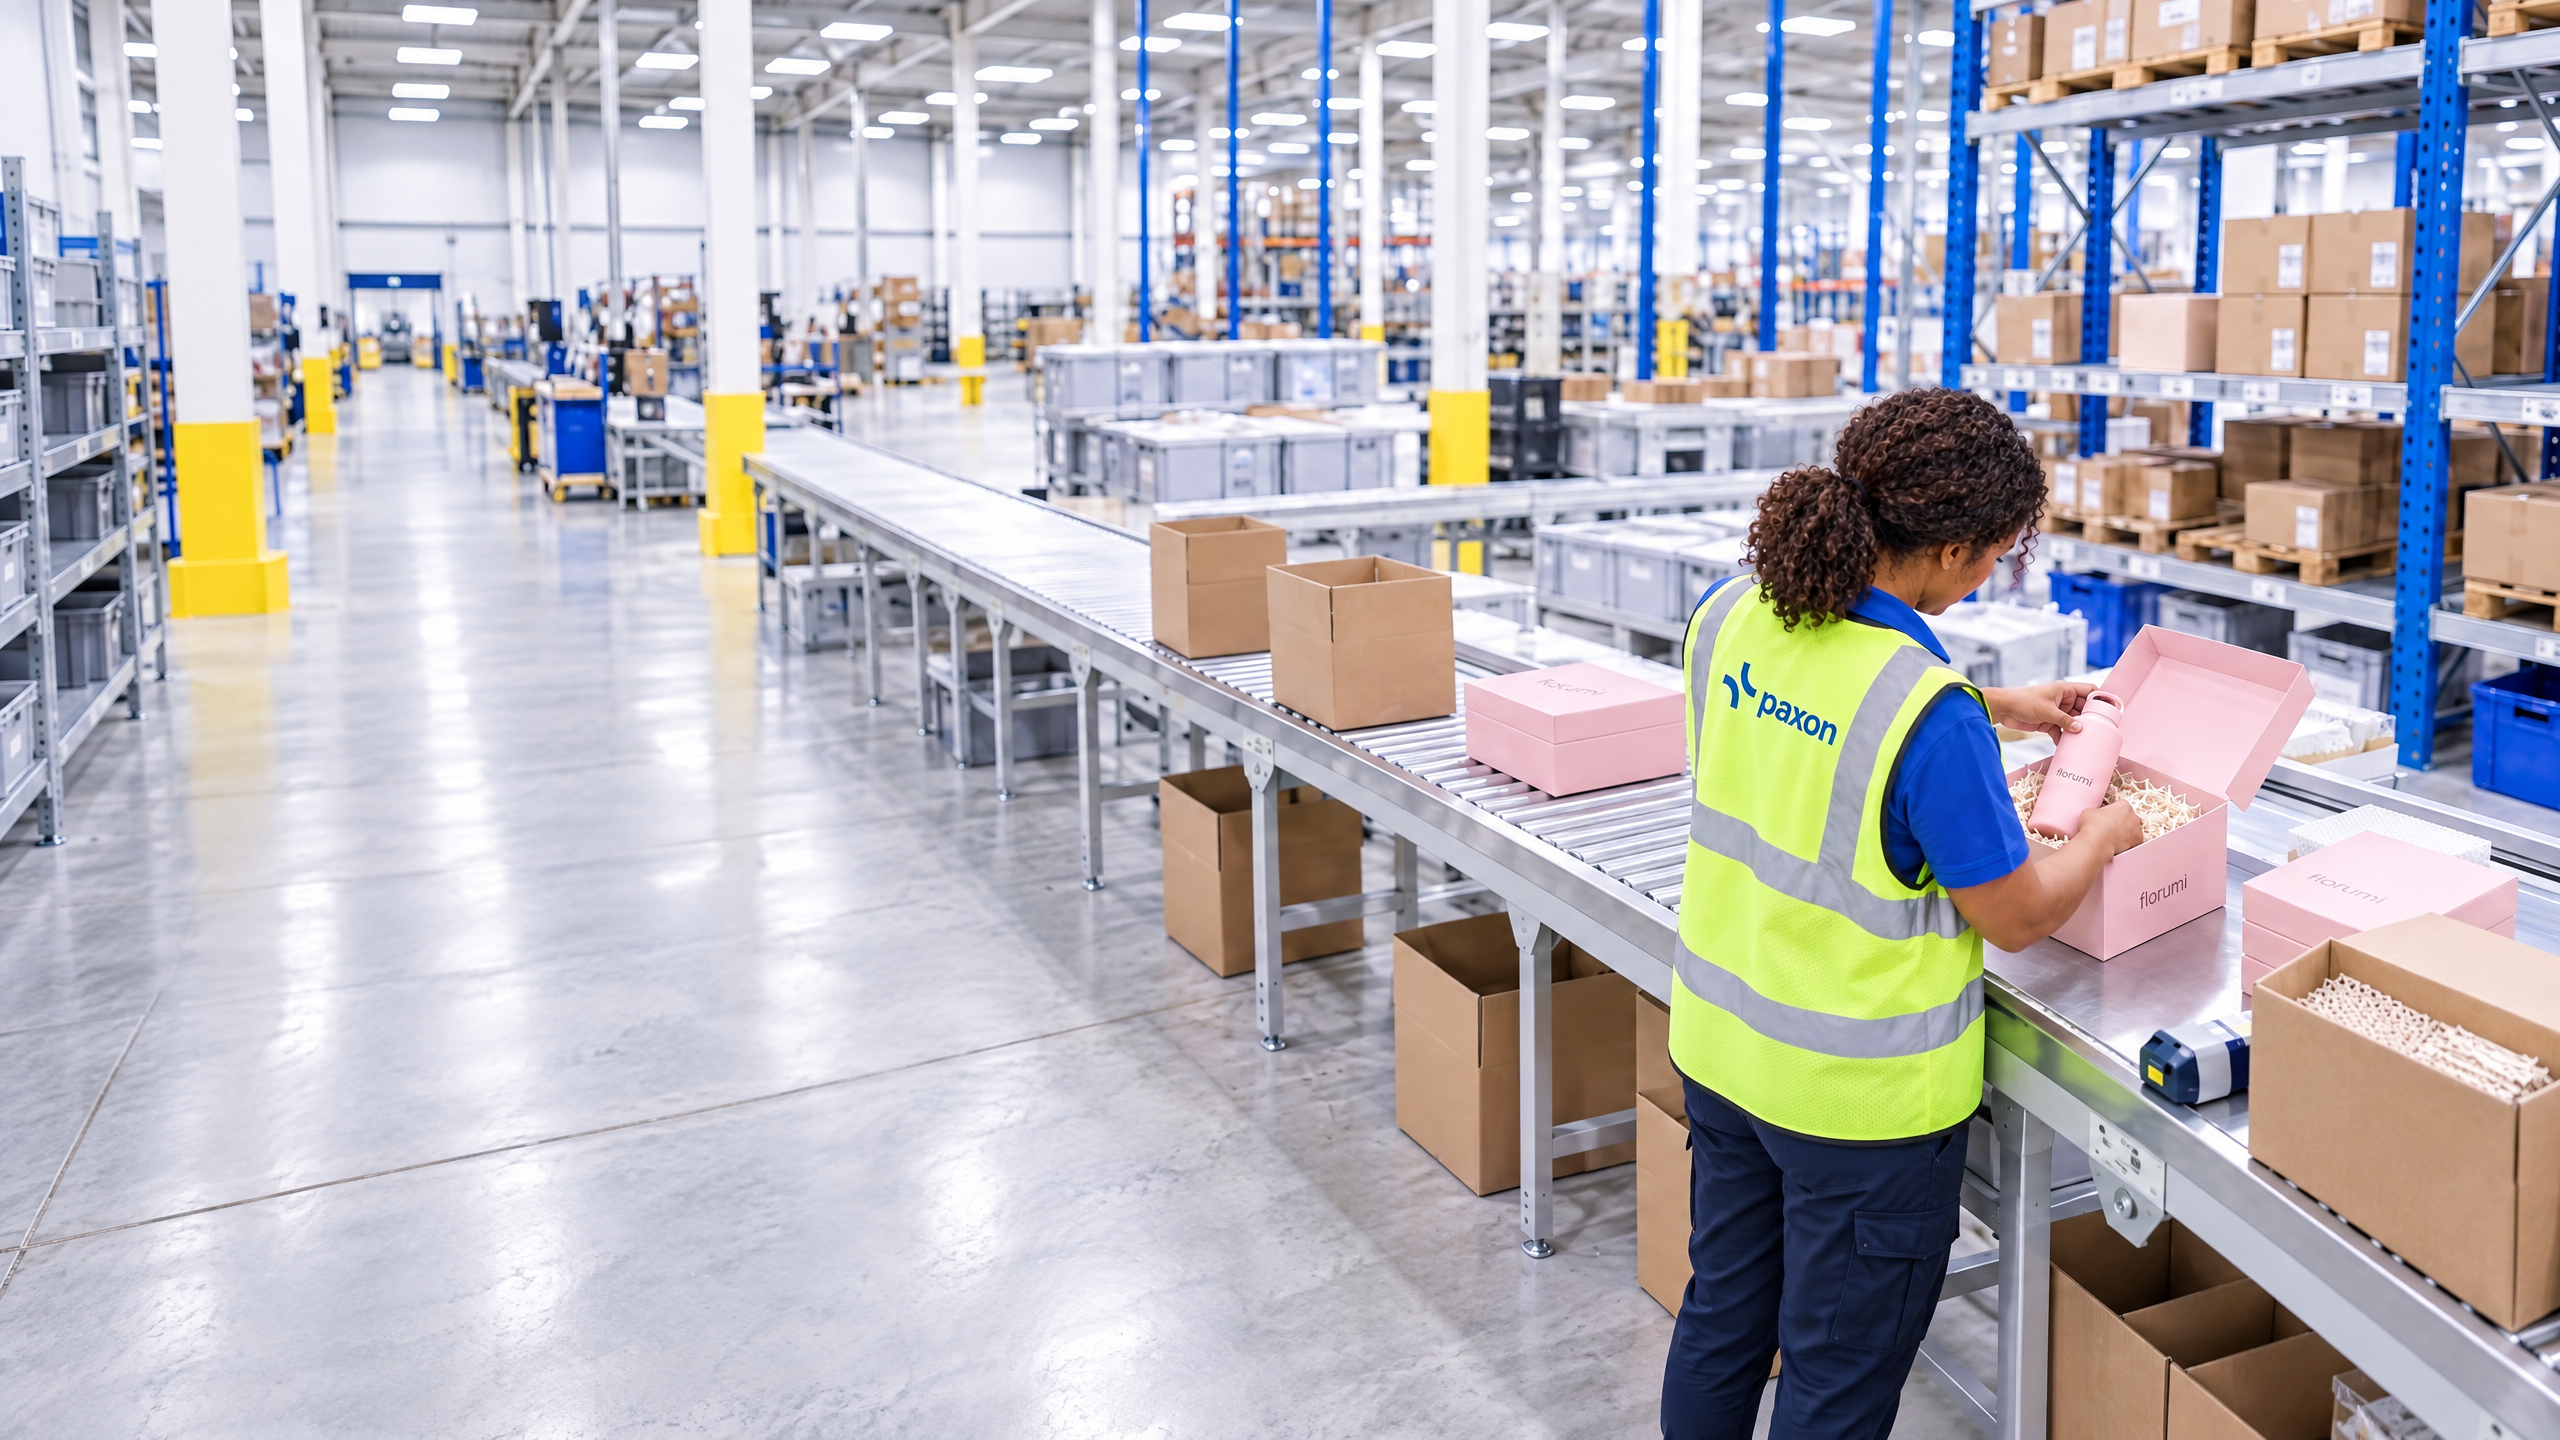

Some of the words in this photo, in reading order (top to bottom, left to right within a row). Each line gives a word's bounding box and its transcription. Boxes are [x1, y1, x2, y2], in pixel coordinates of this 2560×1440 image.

[1756, 691, 1838, 746] paxon
[2056, 767, 2094, 787] florumi
[2139, 873, 2188, 910] florumi
[2307, 873, 2388, 904] florumi
